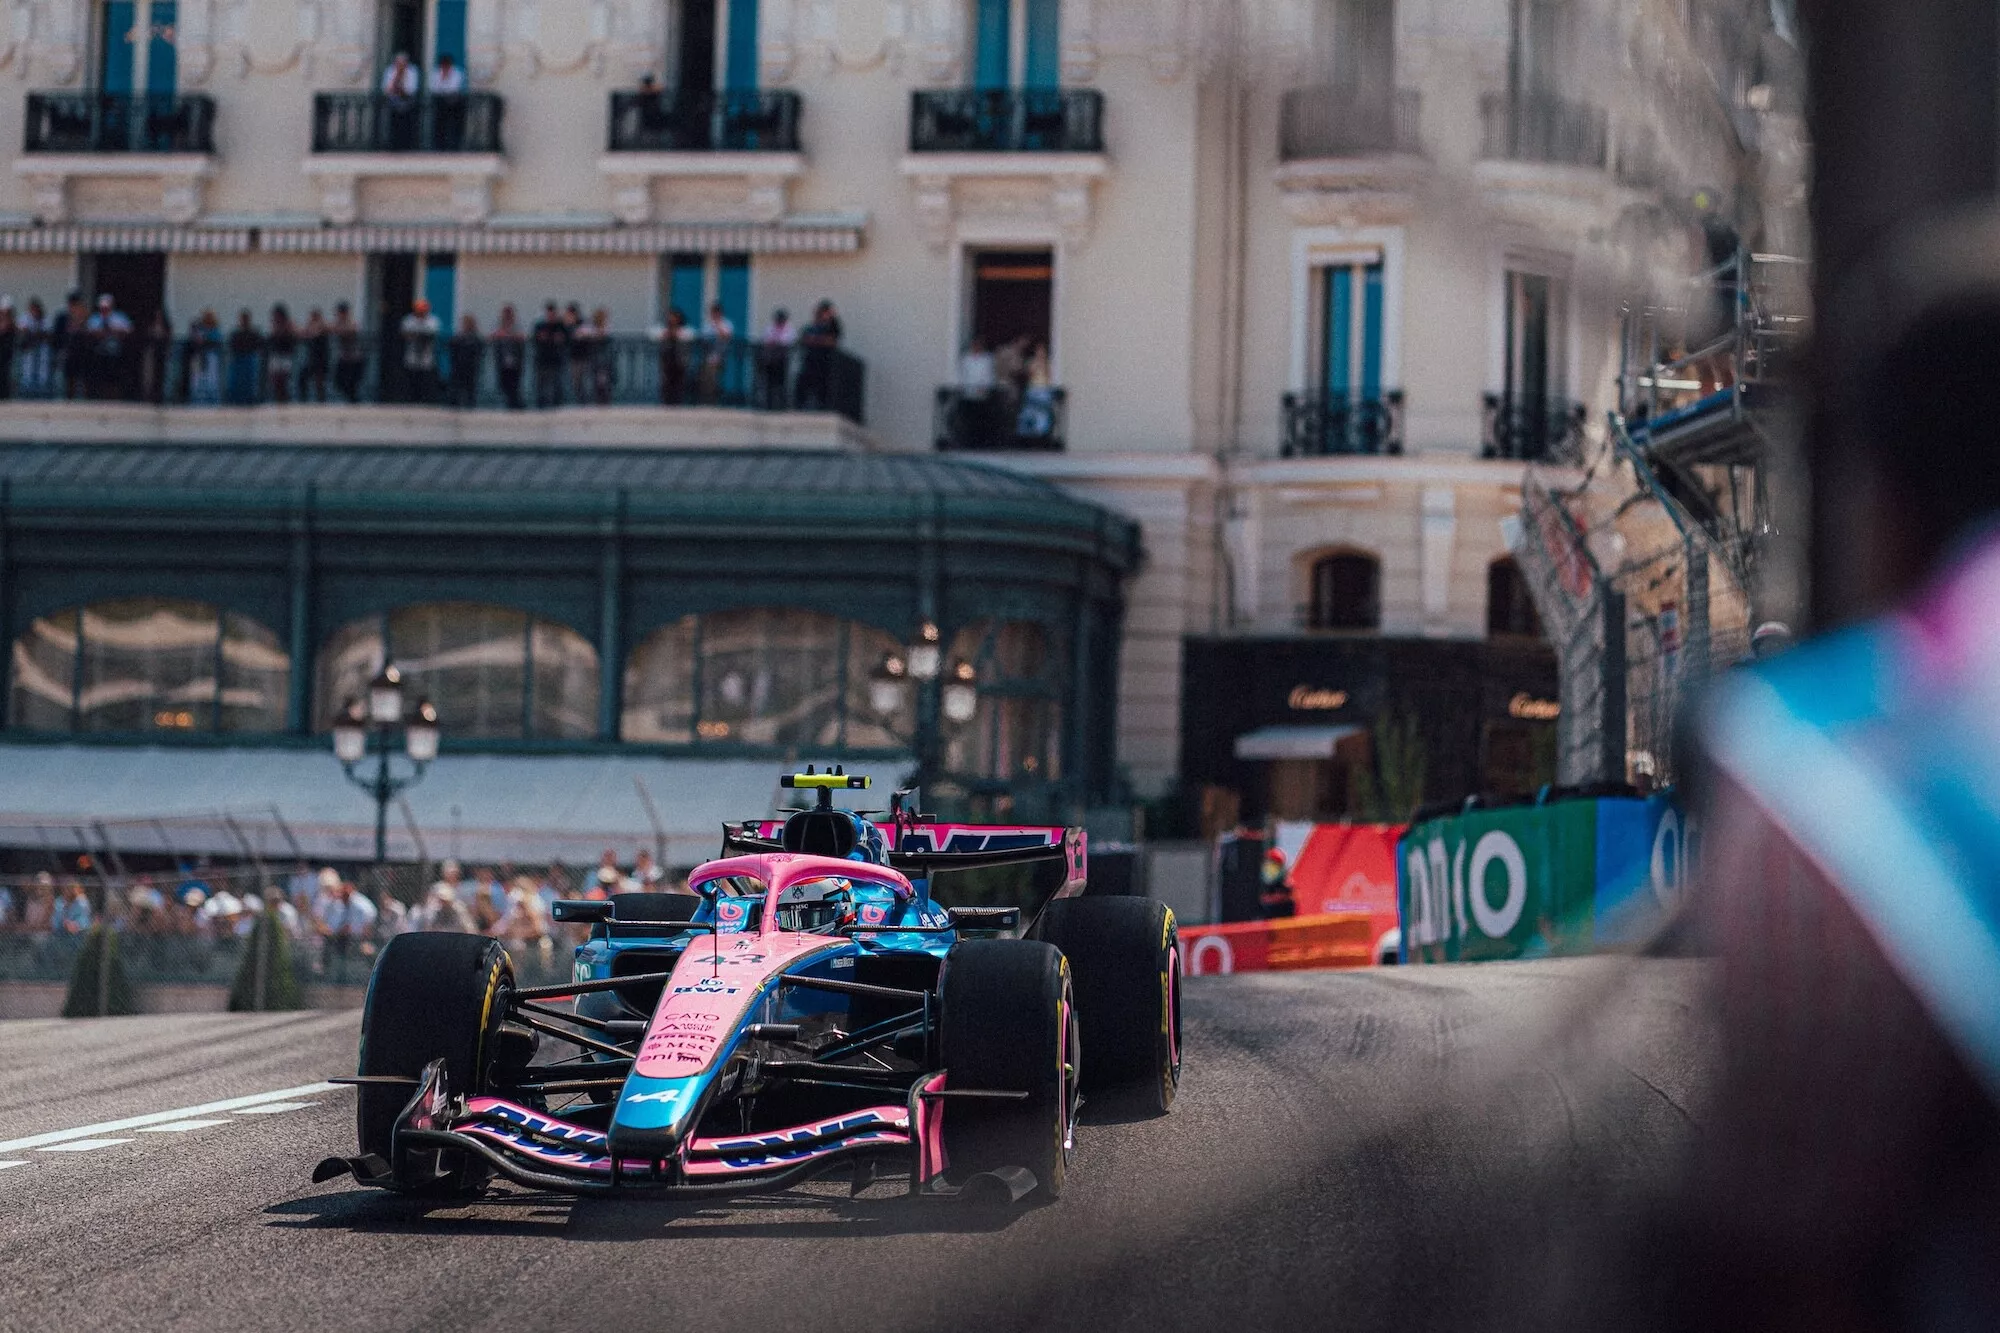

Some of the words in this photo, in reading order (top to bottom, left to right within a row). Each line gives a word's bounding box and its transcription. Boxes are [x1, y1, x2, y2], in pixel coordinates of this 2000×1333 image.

[673, 985, 744, 997] BWT
[665, 1012, 720, 1021] CATO
[666, 1042, 712, 1053] MSC
[640, 1052, 673, 1062] eni
